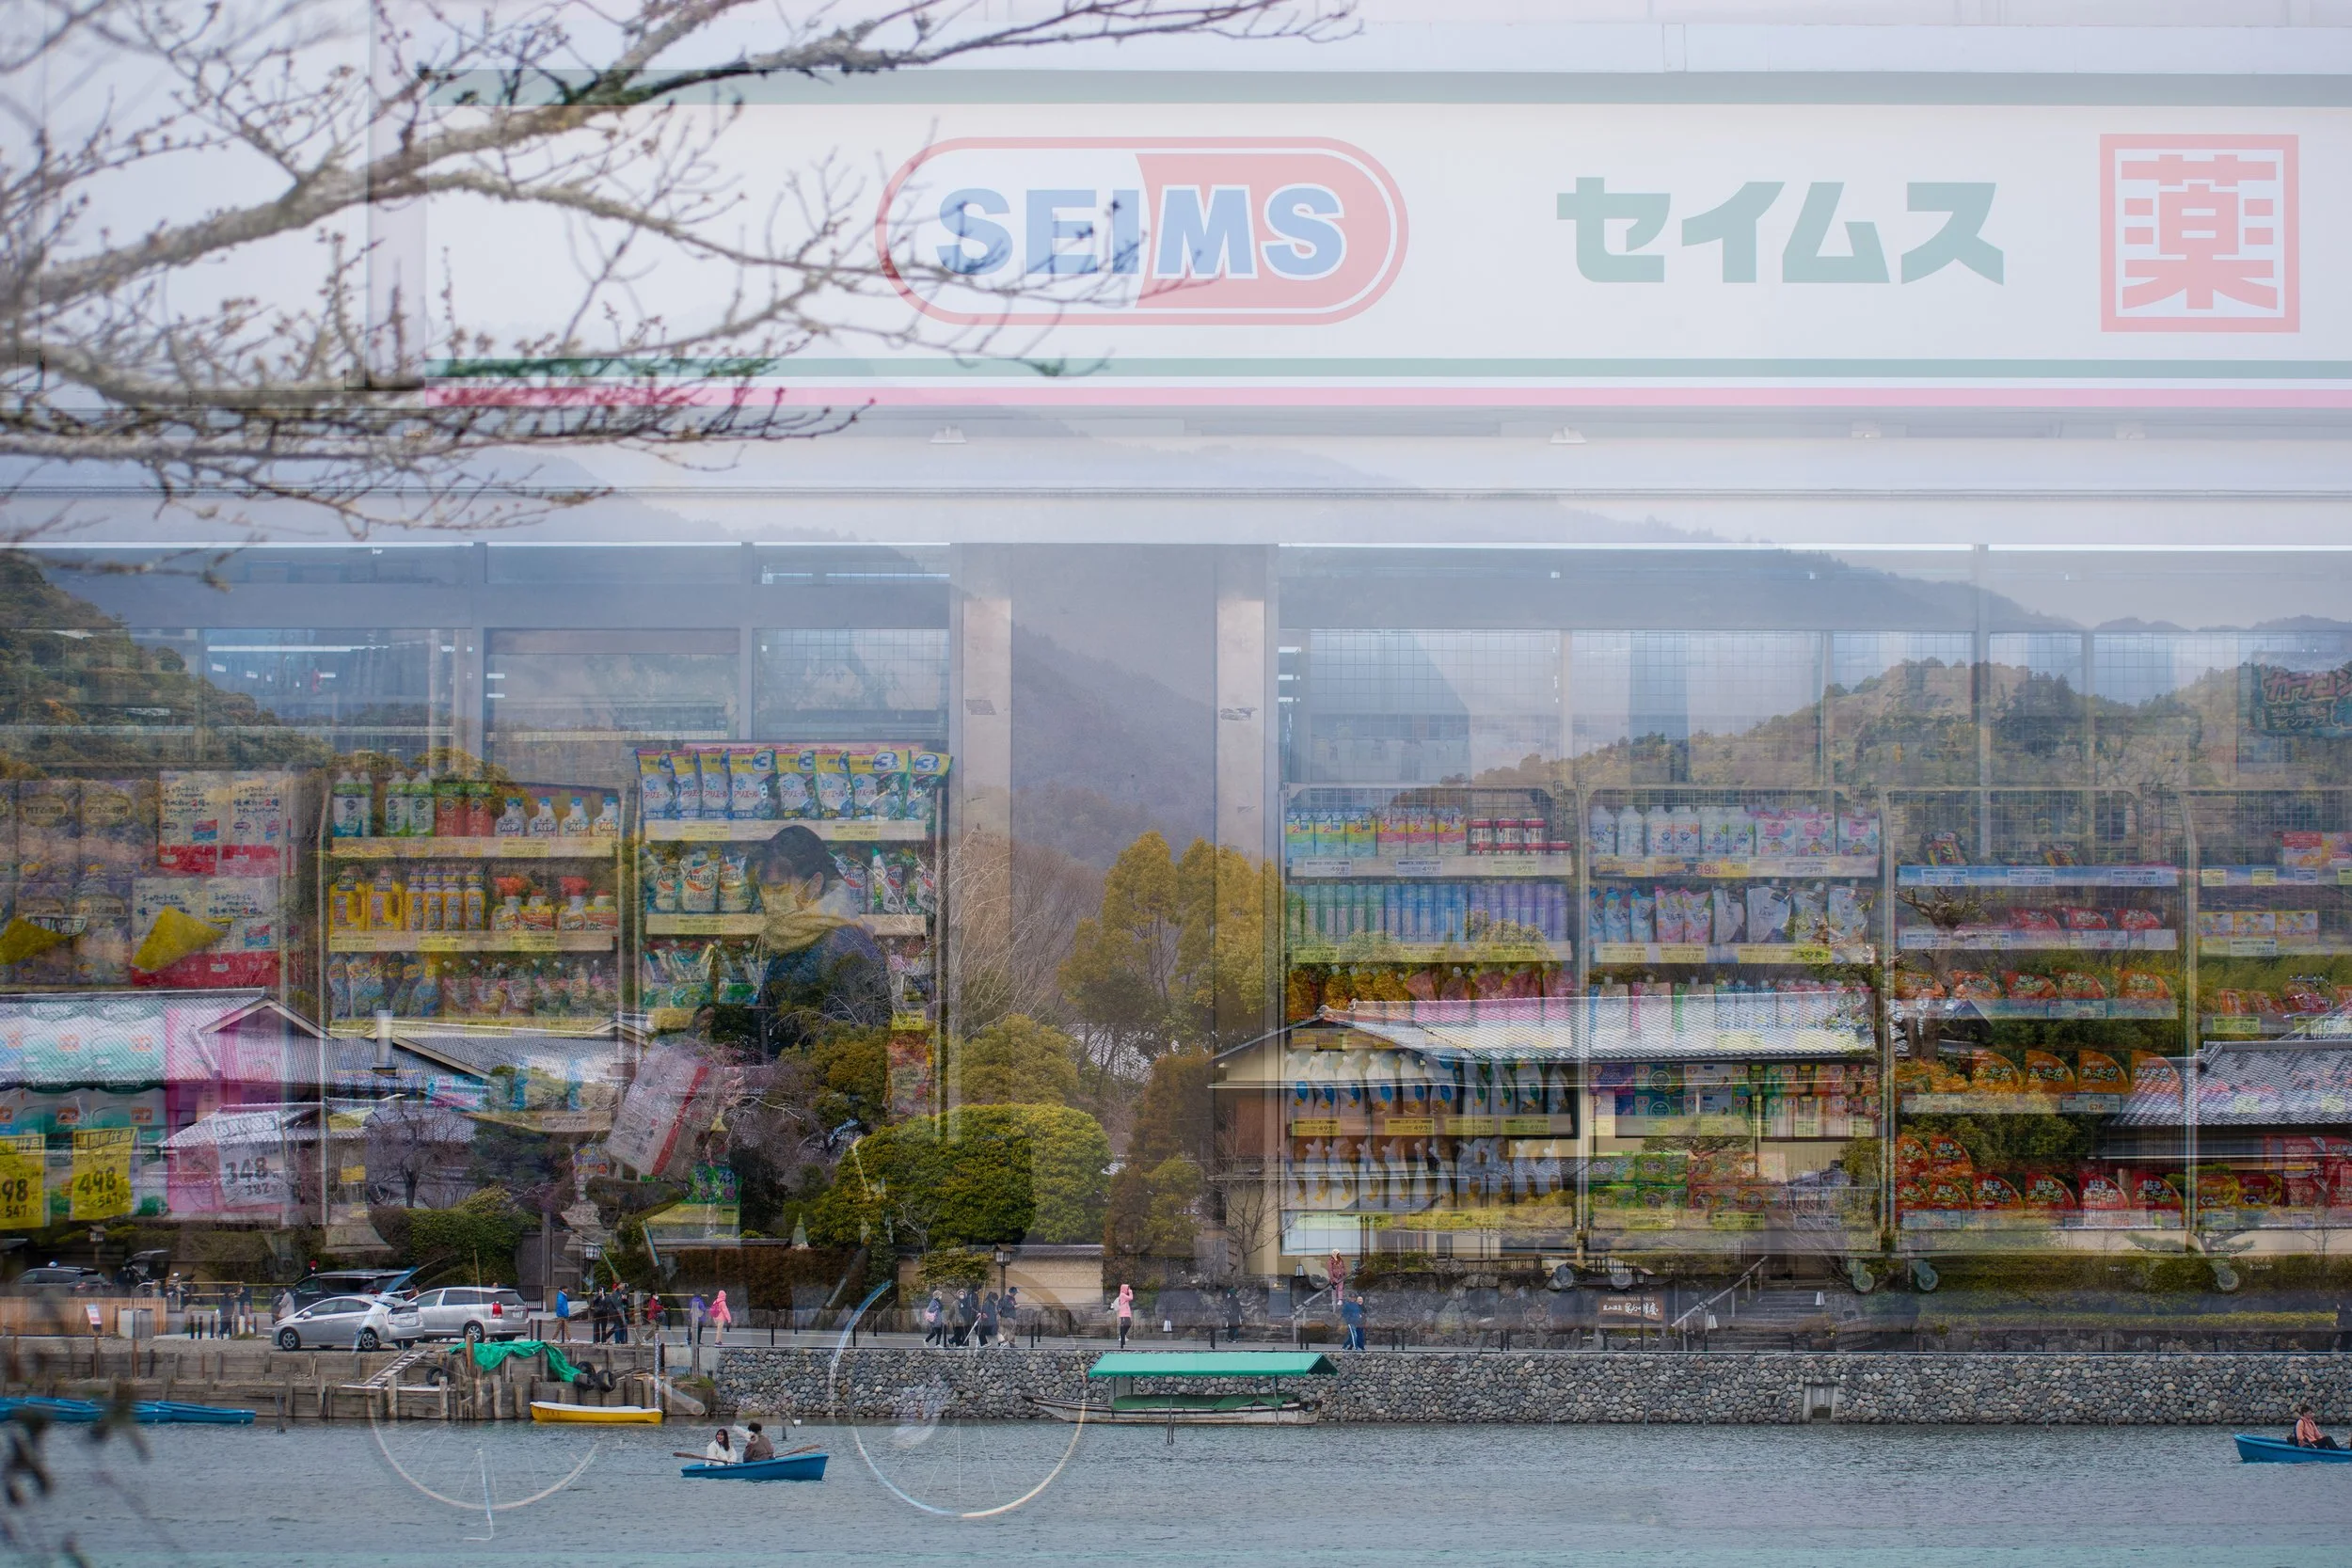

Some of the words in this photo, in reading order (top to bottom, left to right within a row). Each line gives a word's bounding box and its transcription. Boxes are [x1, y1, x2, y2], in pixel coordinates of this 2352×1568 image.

[935, 187, 1345, 276] SEIMS
[1557, 176, 2004, 284] セイムス
[2122, 155, 2280, 310] 薬
[79, 1166, 118, 1195] 498
[225, 1157, 268, 1185] 348
[1981, 1180, 2001, 1191] 貼る
[0, 1178, 28, 1203] 98
